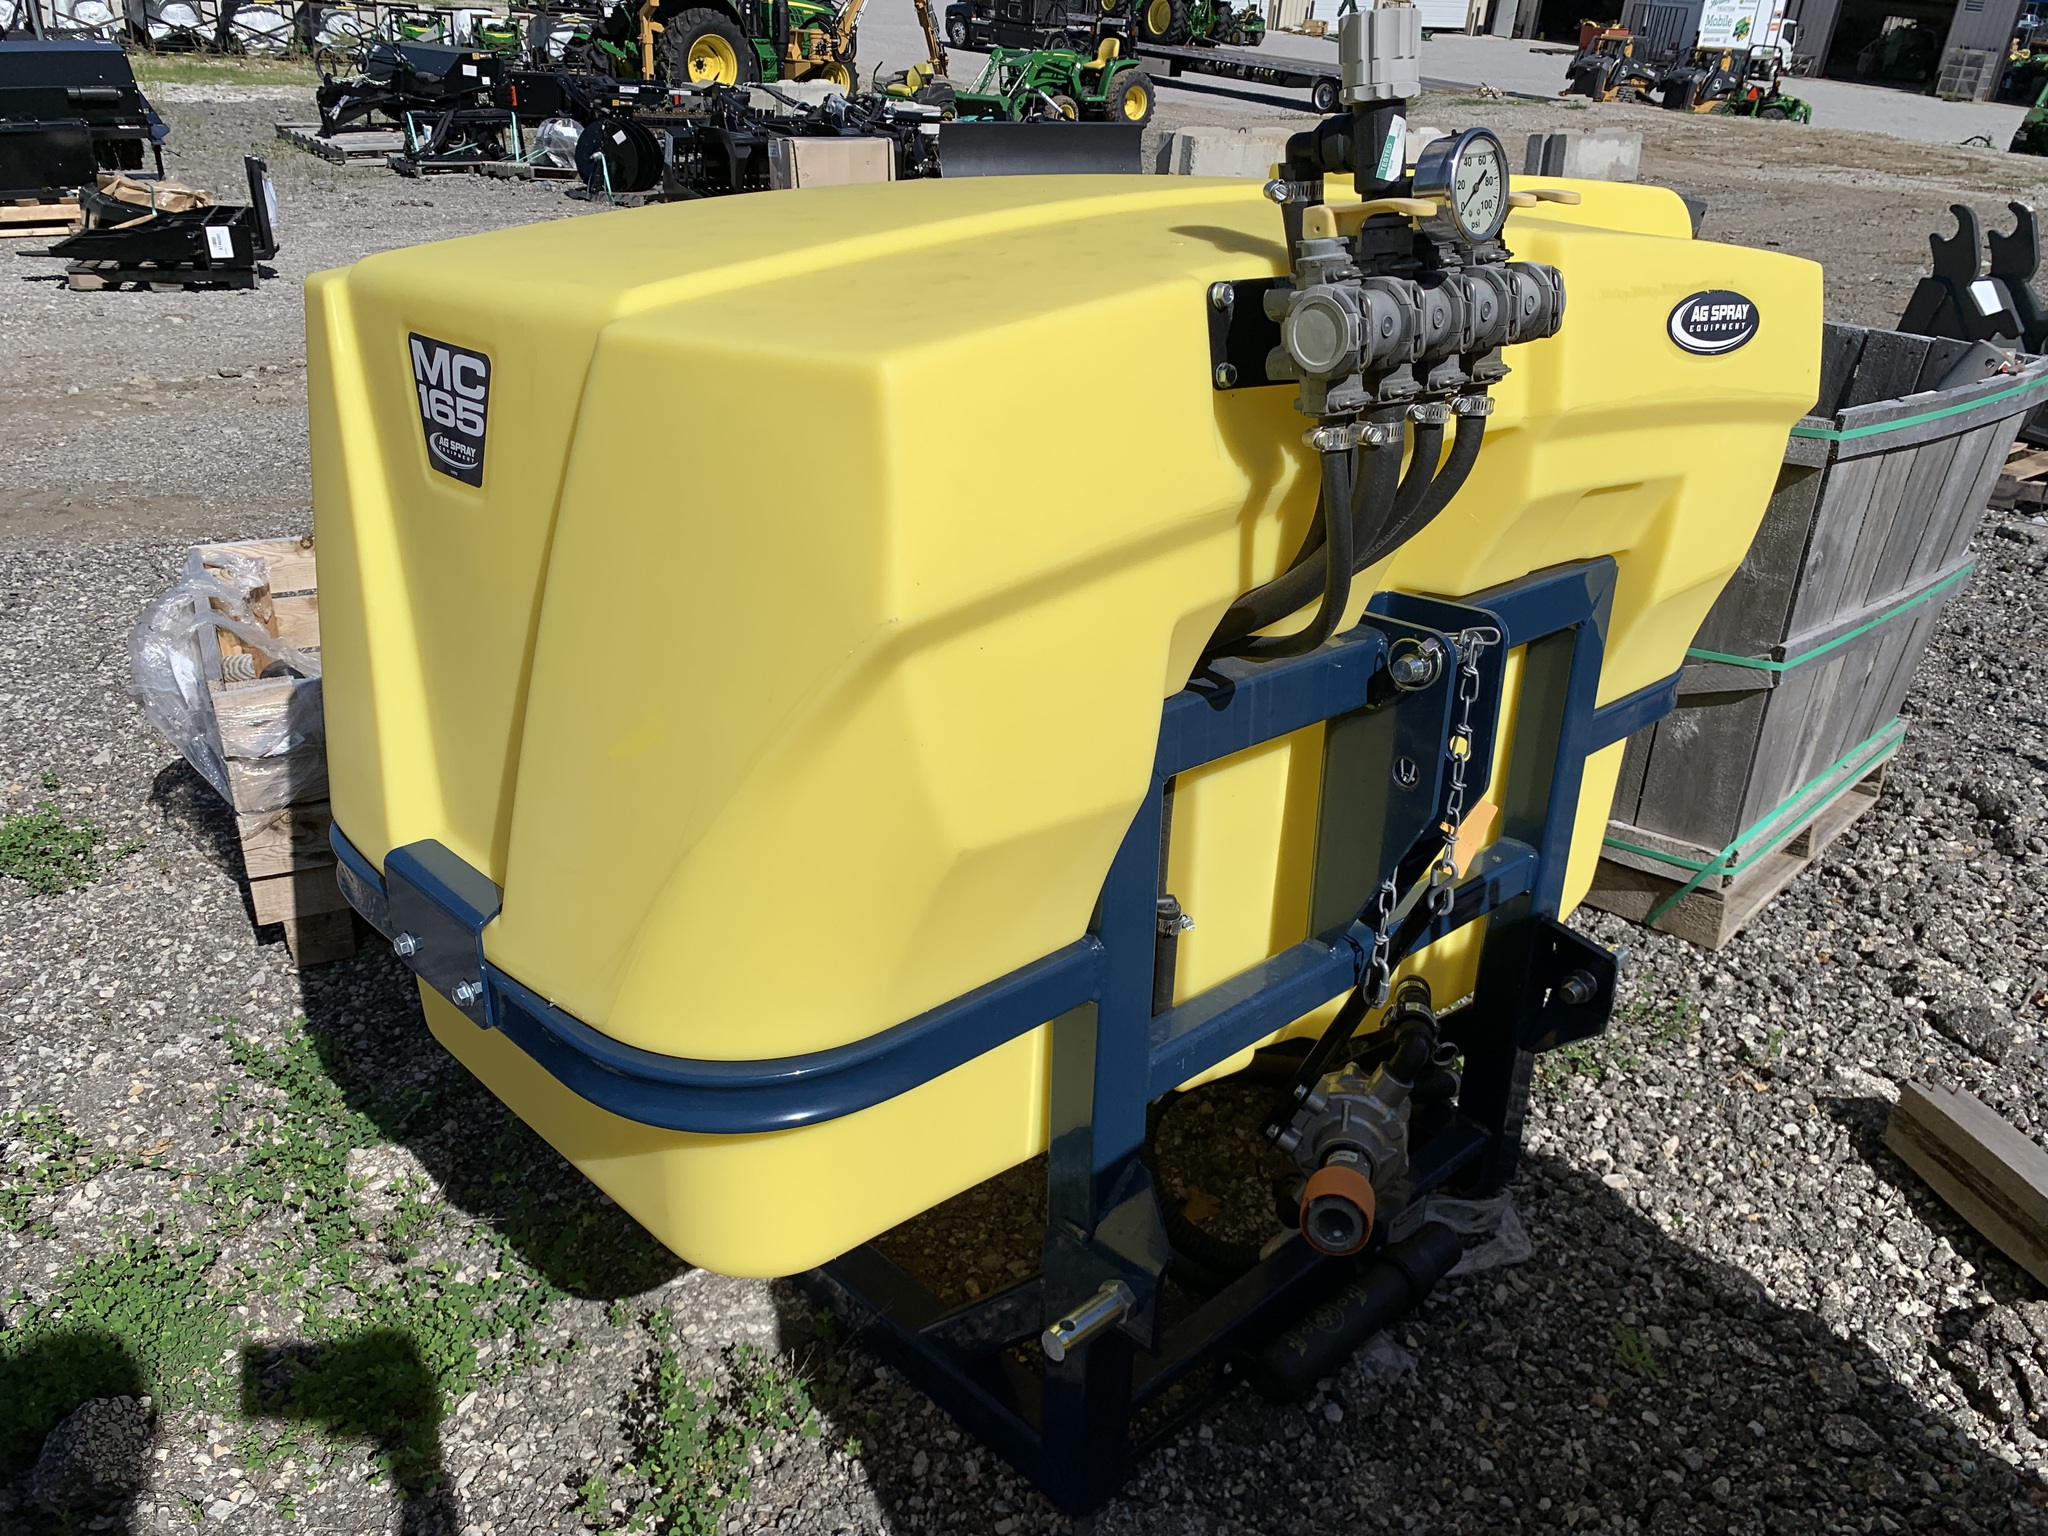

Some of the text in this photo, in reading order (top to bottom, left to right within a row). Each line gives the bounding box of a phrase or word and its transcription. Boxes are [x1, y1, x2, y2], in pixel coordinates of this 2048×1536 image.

[1704, 14, 1733, 27] Mobile
[1380, 143, 1393, 171] TESTED
[1464, 156, 1486, 167] 40 60
[1457, 177, 1493, 190] 20 80
[1460, 199, 1493, 211] 0 100
[1471, 220, 1480, 230] psi
[1691, 304, 1750, 322] AG SPRAY
[1689, 322, 1746, 332] EQUIPMENT
[411, 339, 486, 400] MC
[418, 384, 484, 437] 165
[438, 436, 476, 458] AG SPRAY
[438, 445, 475, 463] EQUIPMENT
